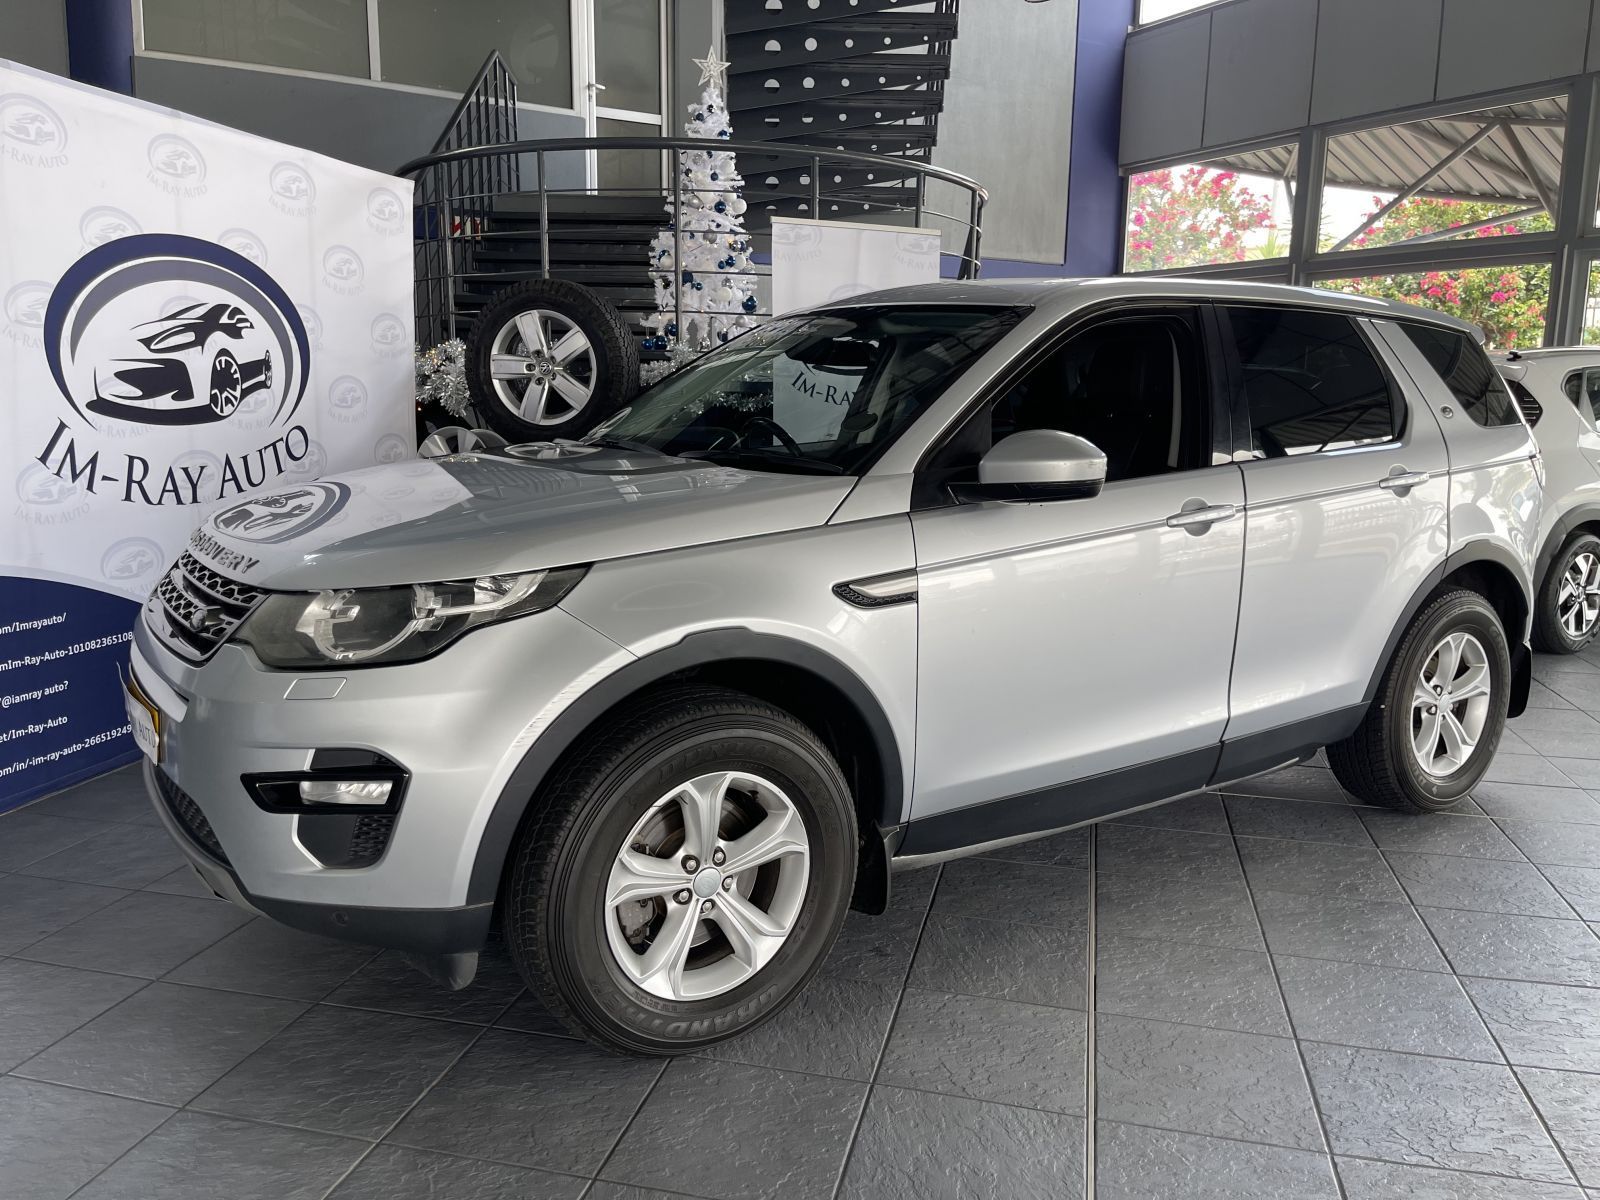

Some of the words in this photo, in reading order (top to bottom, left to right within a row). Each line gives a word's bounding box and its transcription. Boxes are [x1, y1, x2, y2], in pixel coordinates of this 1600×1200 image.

[790, 371, 857, 406] IM-RA
[34, 416, 209, 507] IM-RAY
[215, 425, 310, 501] AUTO
[44, 680, 69, 696] auto?
